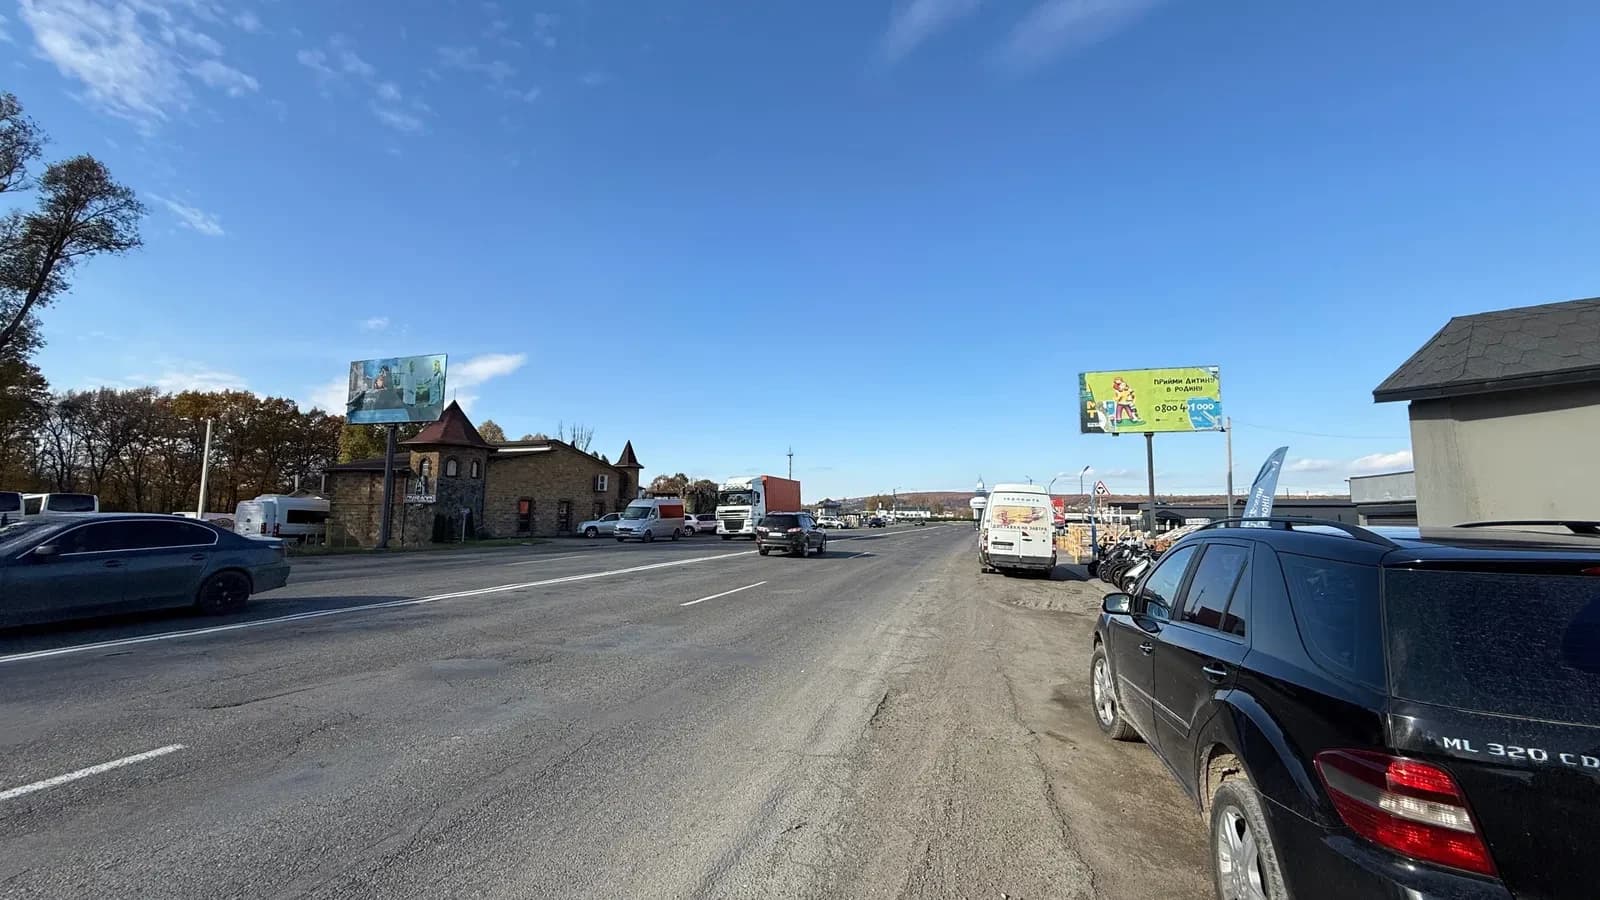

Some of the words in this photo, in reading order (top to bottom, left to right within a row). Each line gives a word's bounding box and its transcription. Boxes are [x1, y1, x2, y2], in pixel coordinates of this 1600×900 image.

[1153, 377, 1183, 385] ПРИЙМИ
[1154, 403, 1178, 413] 0800
[1442, 736, 1479, 753] ML
[1486, 743, 1548, 761] 320
